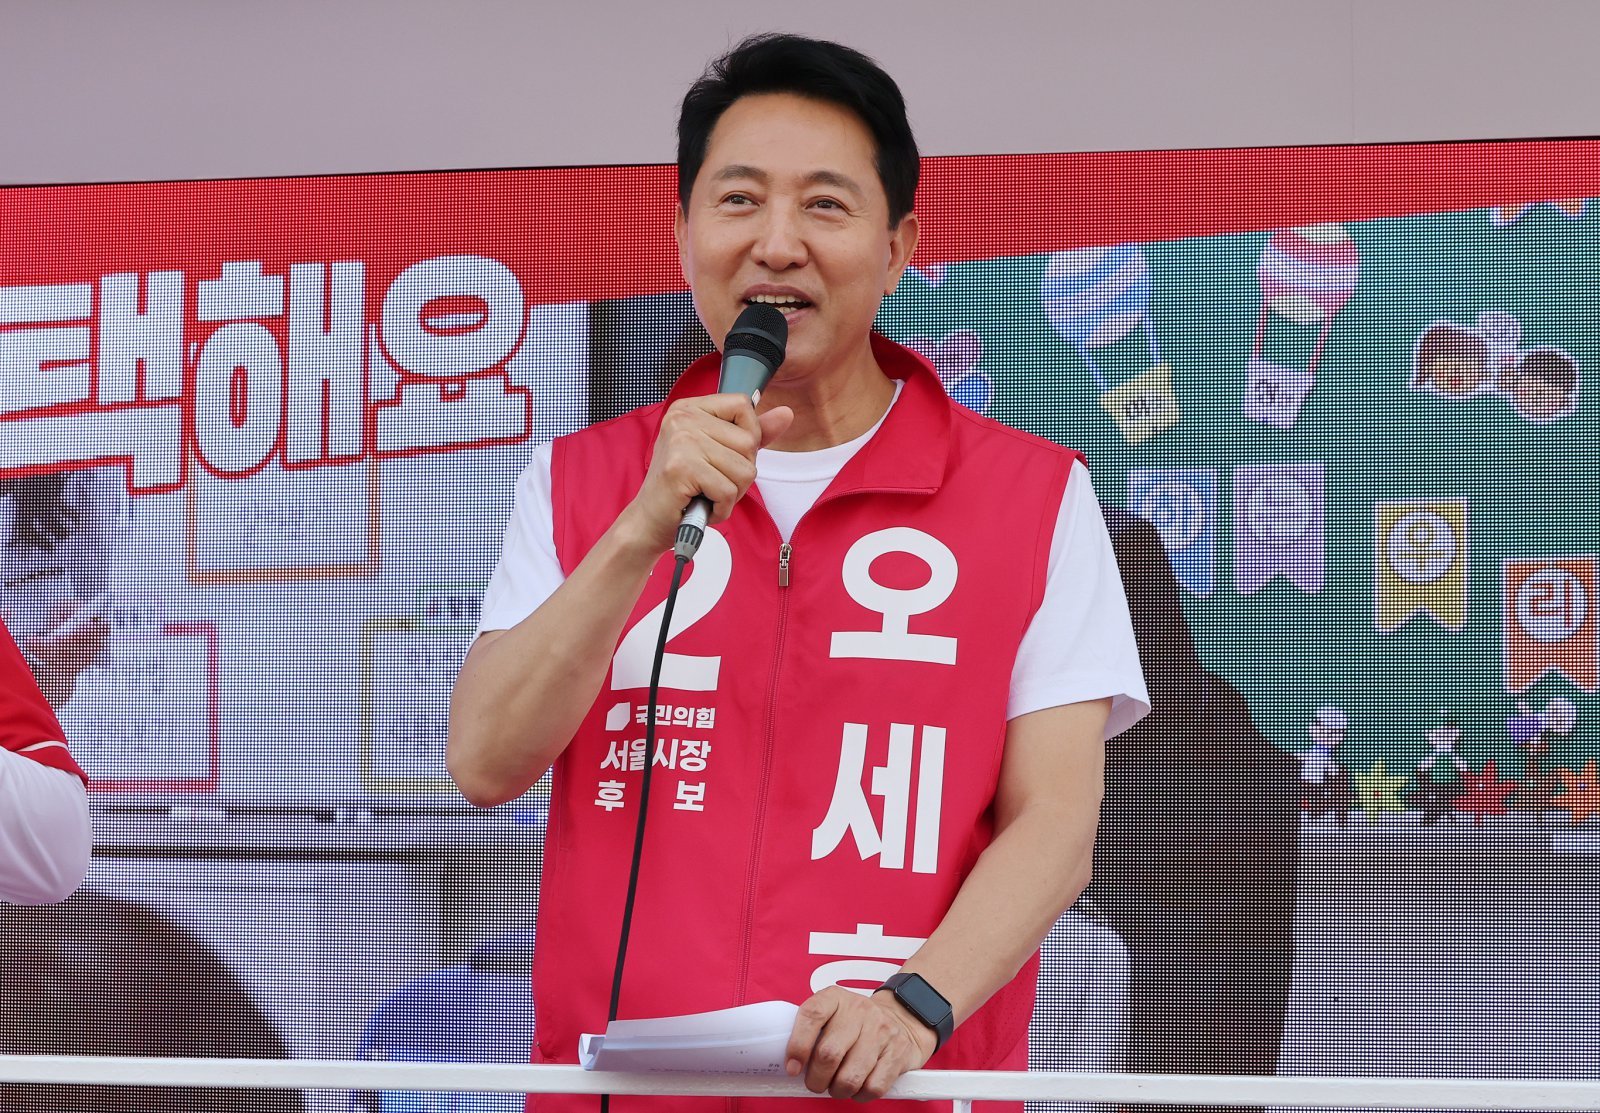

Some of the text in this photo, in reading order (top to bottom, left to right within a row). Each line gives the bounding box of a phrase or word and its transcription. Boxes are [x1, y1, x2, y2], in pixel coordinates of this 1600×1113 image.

[611, 525, 733, 692] 2
[635, 704, 716, 729] 국민의힘
[600, 738, 712, 772] 서울시장
